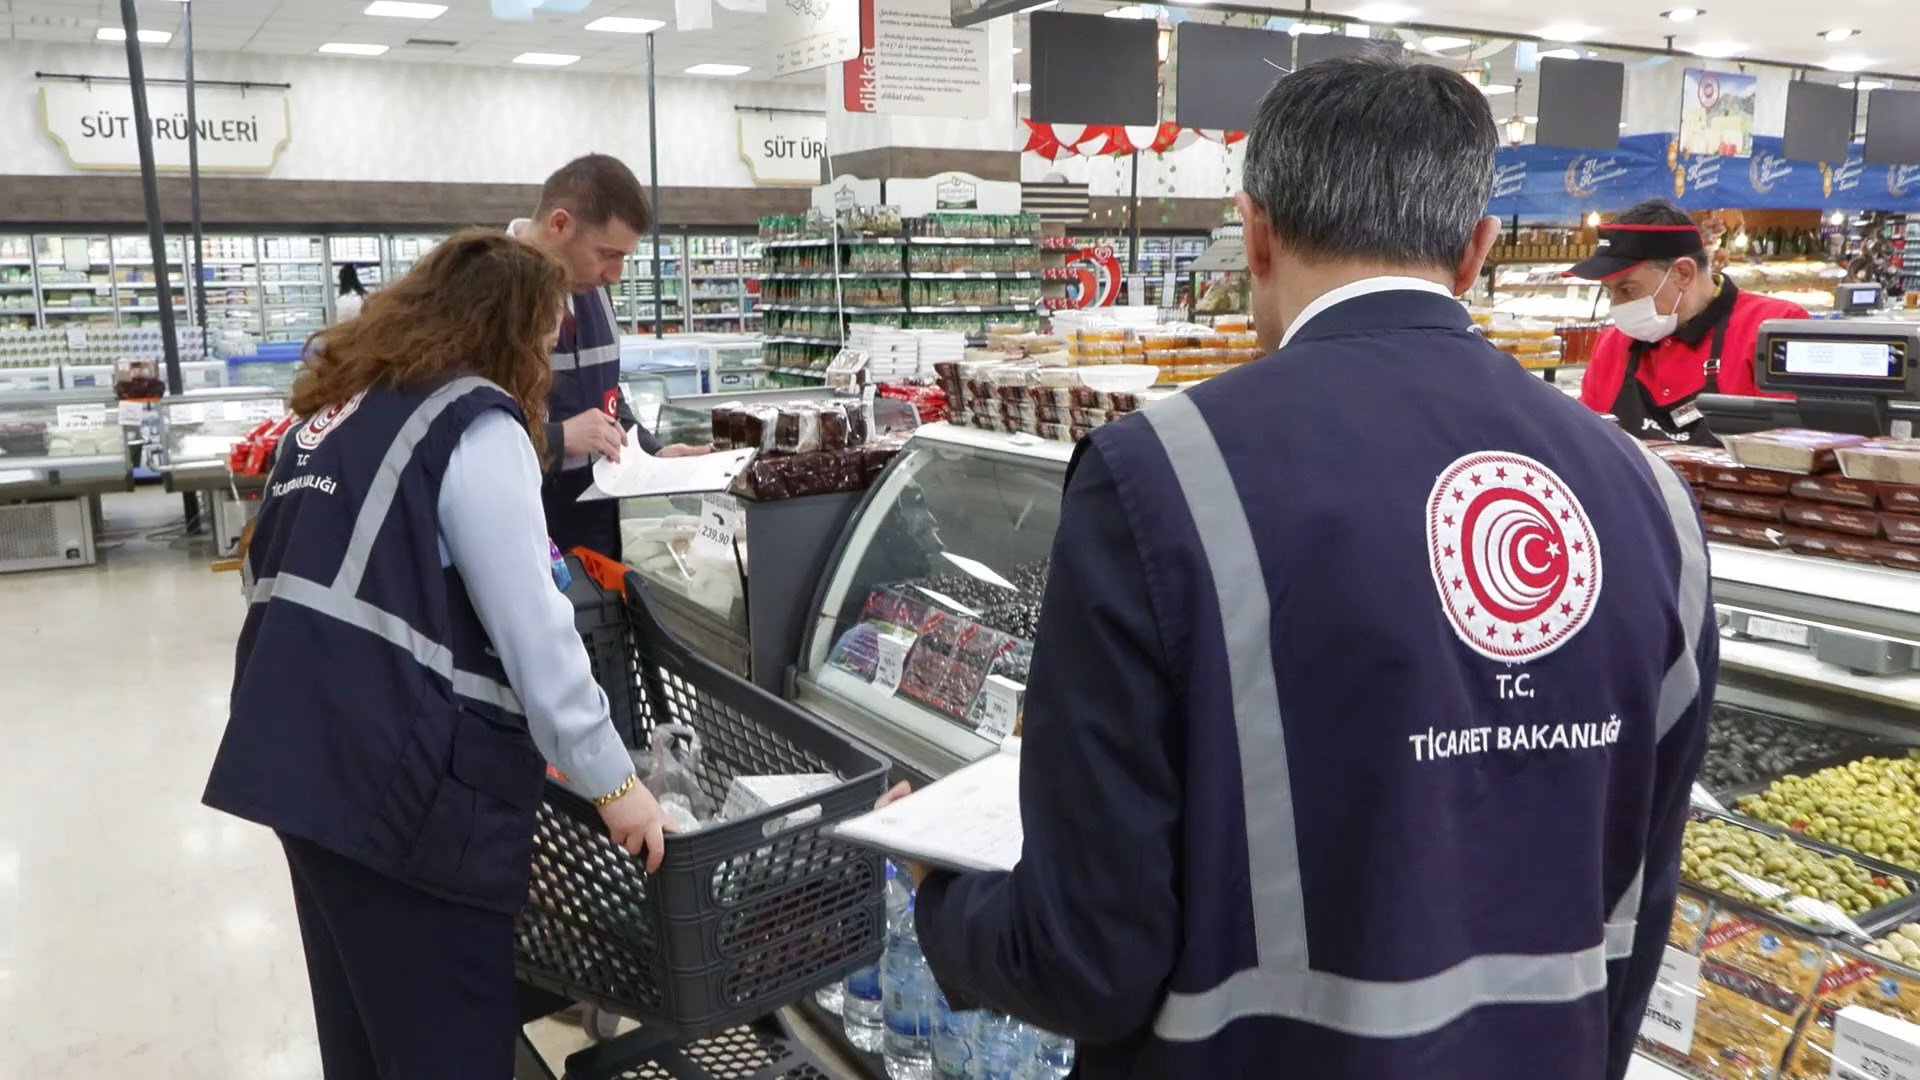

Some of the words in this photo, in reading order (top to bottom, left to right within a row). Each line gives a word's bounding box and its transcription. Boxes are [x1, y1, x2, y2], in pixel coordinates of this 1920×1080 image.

[859, 47, 877, 113] dikkat
[81, 111, 129, 138] SÜT
[146, 113, 259, 143] RÜNLERİ
[764, 135, 796, 159] SÜT
[701, 525, 730, 546] 239,90
[1496, 673, 1535, 700] T.C.
[1497, 714, 1622, 751] BAKANLIĞI
